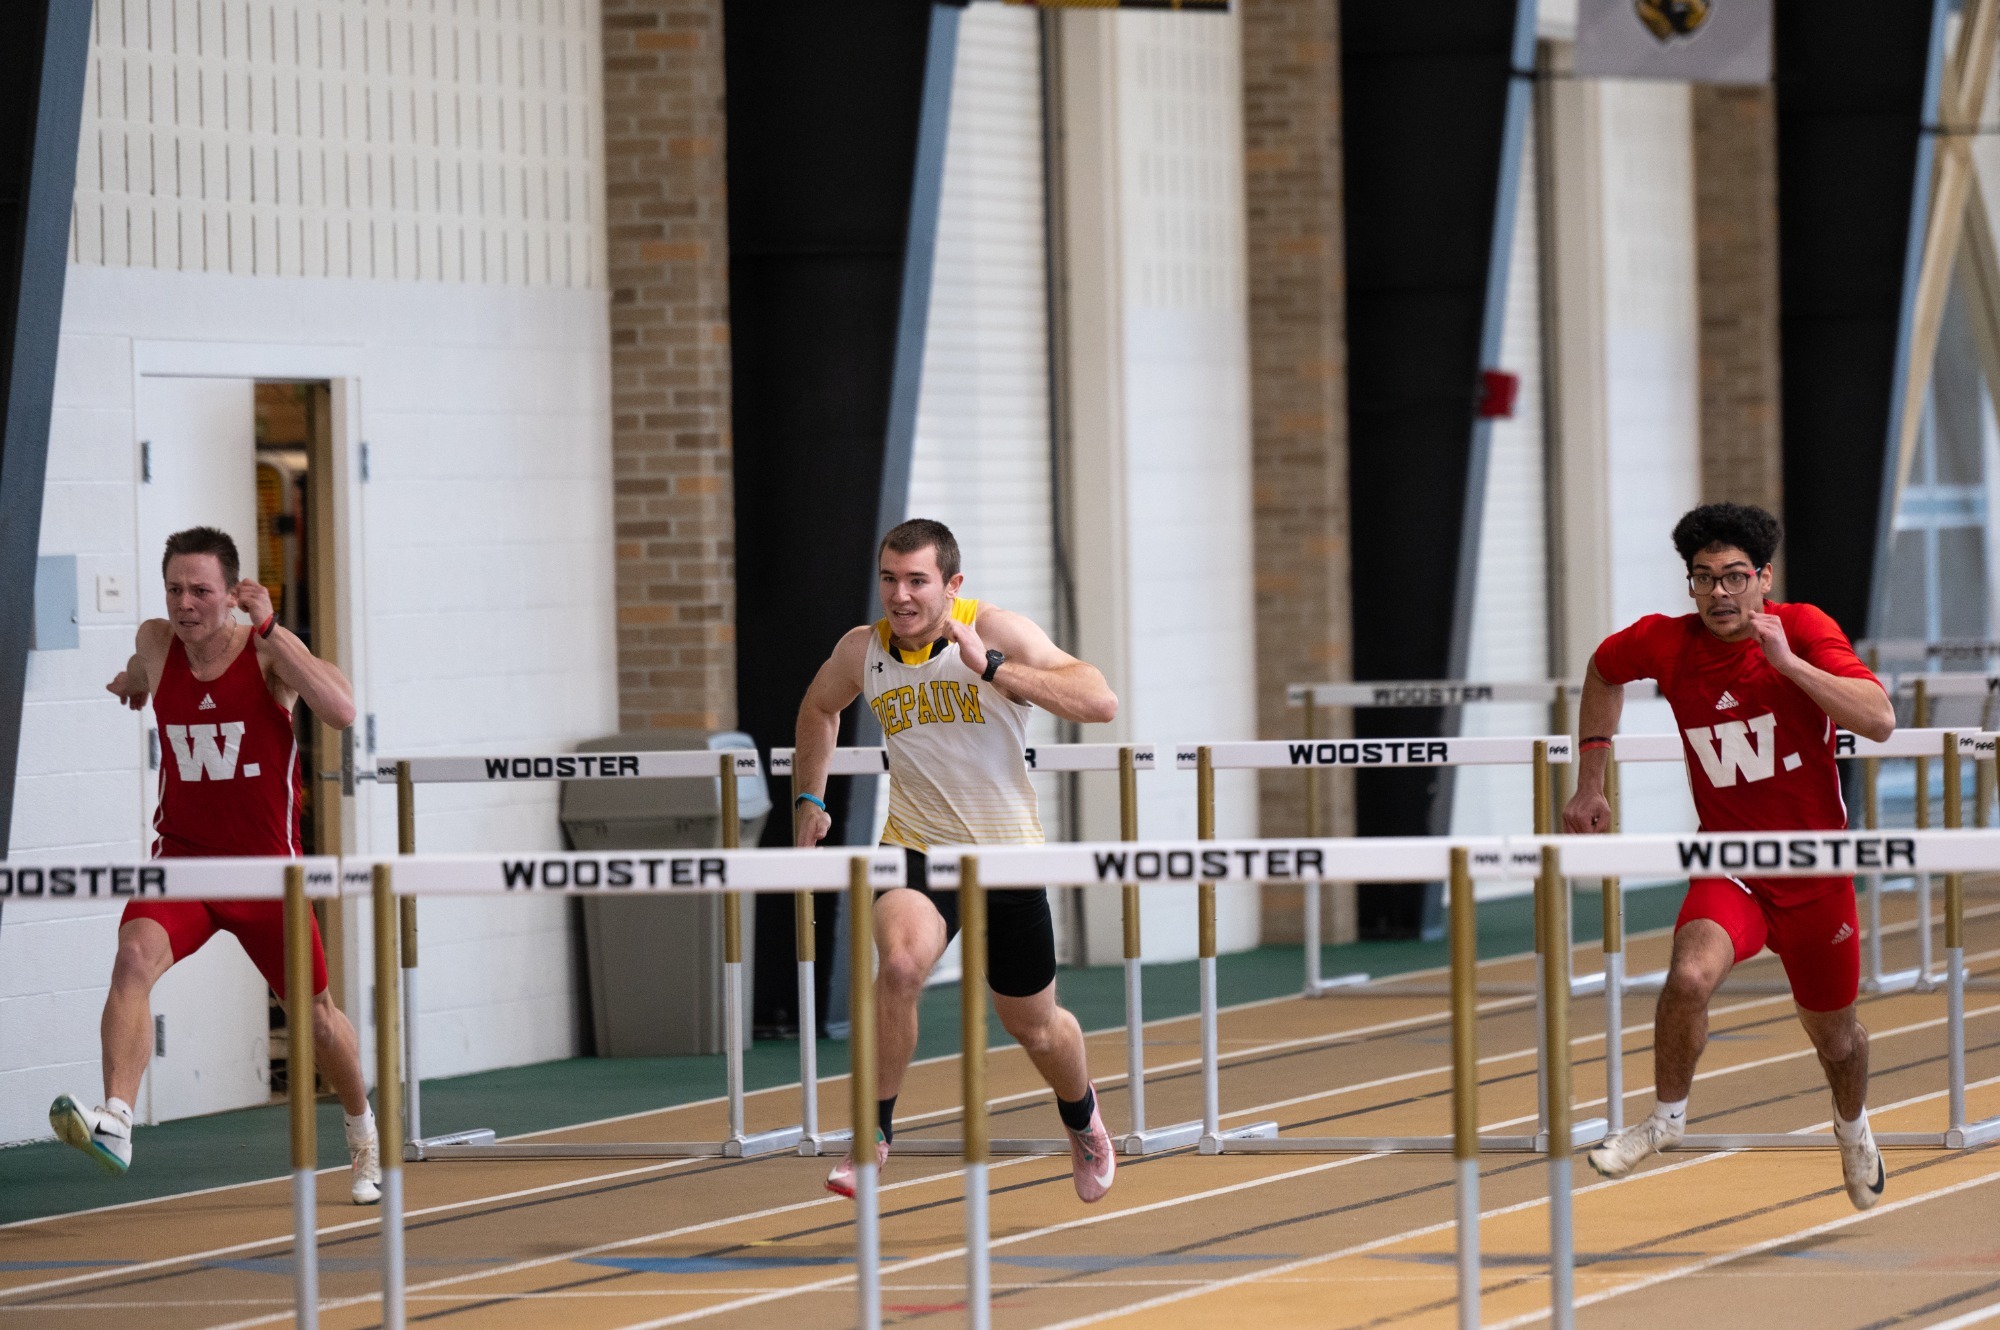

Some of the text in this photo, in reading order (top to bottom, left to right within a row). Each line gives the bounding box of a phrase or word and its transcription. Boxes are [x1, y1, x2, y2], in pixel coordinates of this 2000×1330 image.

[870, 680, 986, 739] DEPAUW
[485, 755, 639, 779] WOOSTER
[1288, 742, 1448, 765] WOOSTER
[1094, 848, 1324, 880] WOOSTER
[1677, 838, 1916, 870] WOOSTER
[502, 858, 727, 890] WOOSTER
